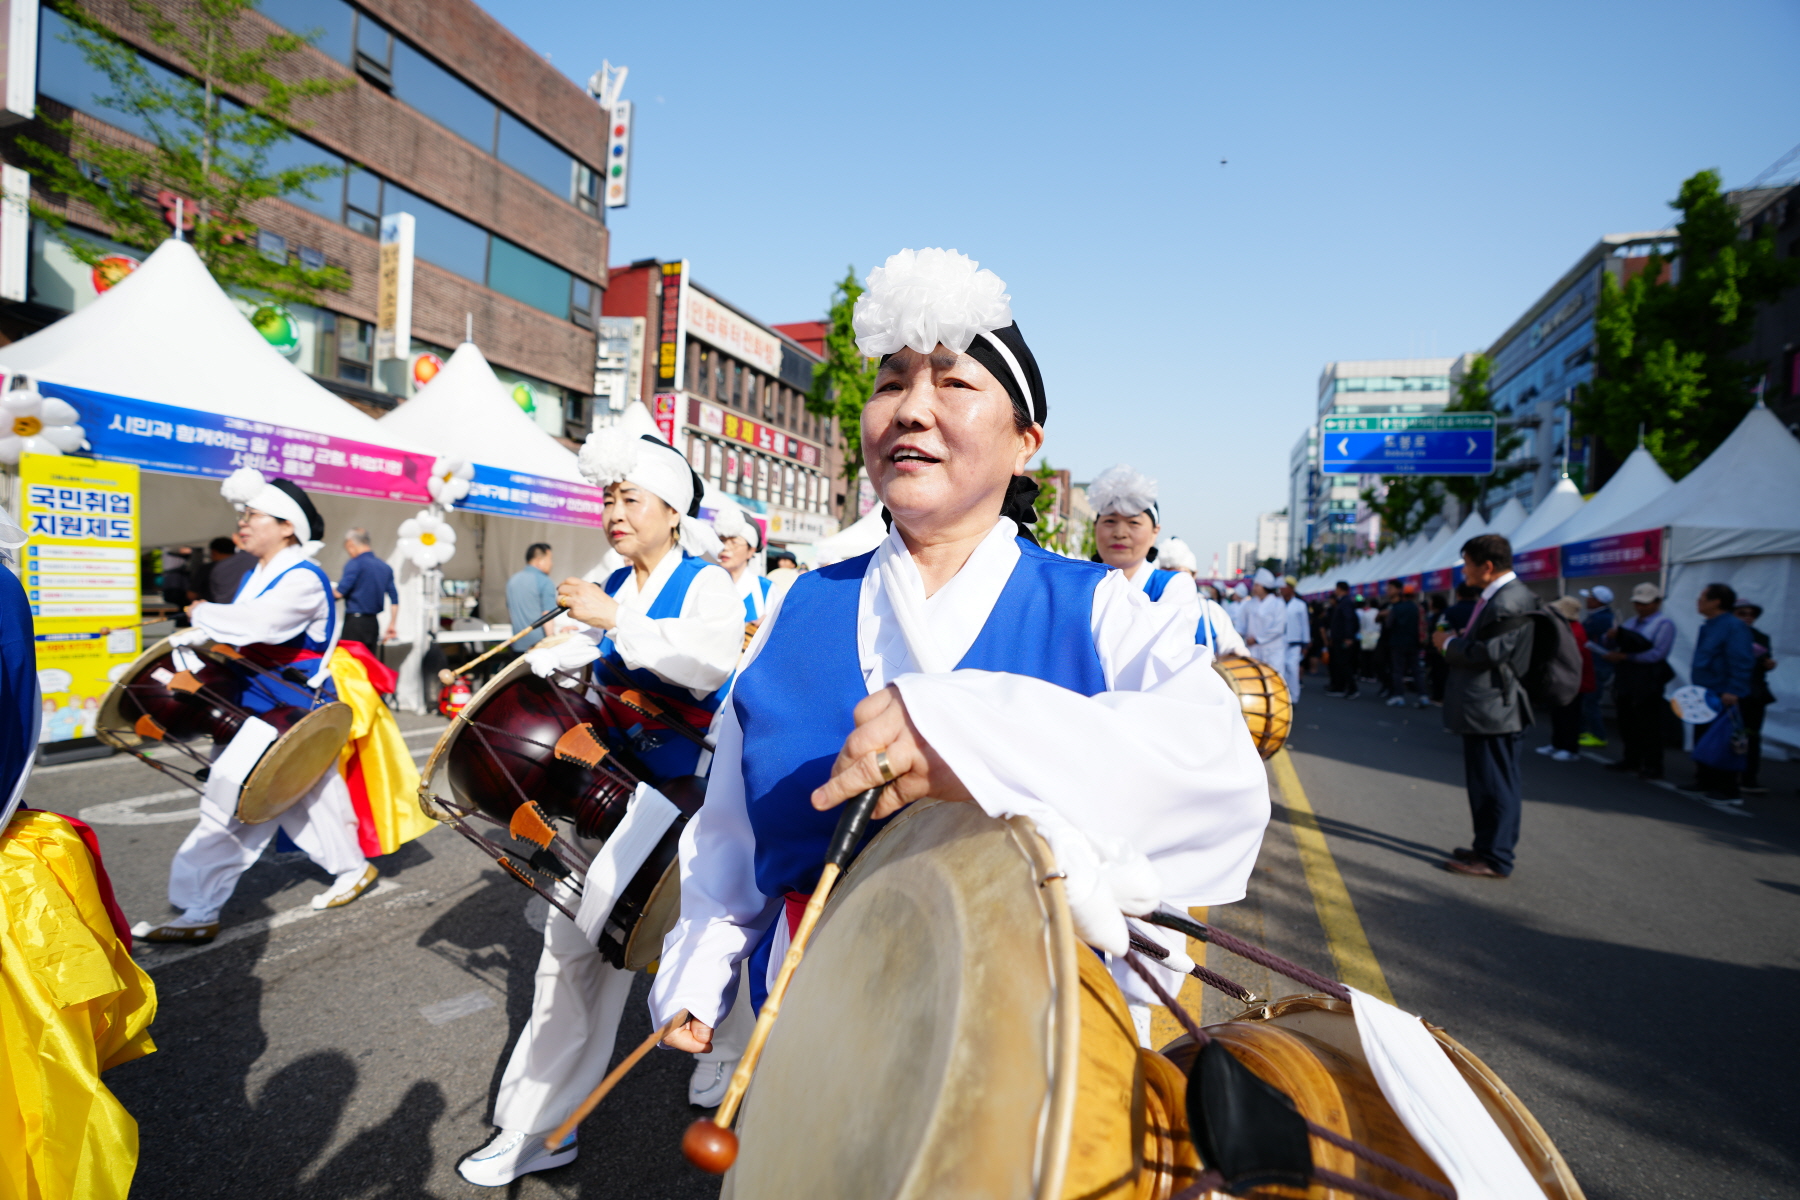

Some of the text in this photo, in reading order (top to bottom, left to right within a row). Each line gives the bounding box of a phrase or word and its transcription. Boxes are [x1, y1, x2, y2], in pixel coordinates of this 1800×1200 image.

[107, 414, 174, 440] 시민과
[175, 424, 249, 451] 함께하는
[250, 436, 270, 454] 일
[281, 442, 315, 461] 생활
[350, 453, 403, 476] 취업지원
[1384, 435, 1427, 450] 도봉로
[229, 451, 281, 473] 서비스
[282, 458, 316, 477] 홍보
[30, 486, 130, 514] 국민취업
[31, 514, 131, 539] 지원제도
